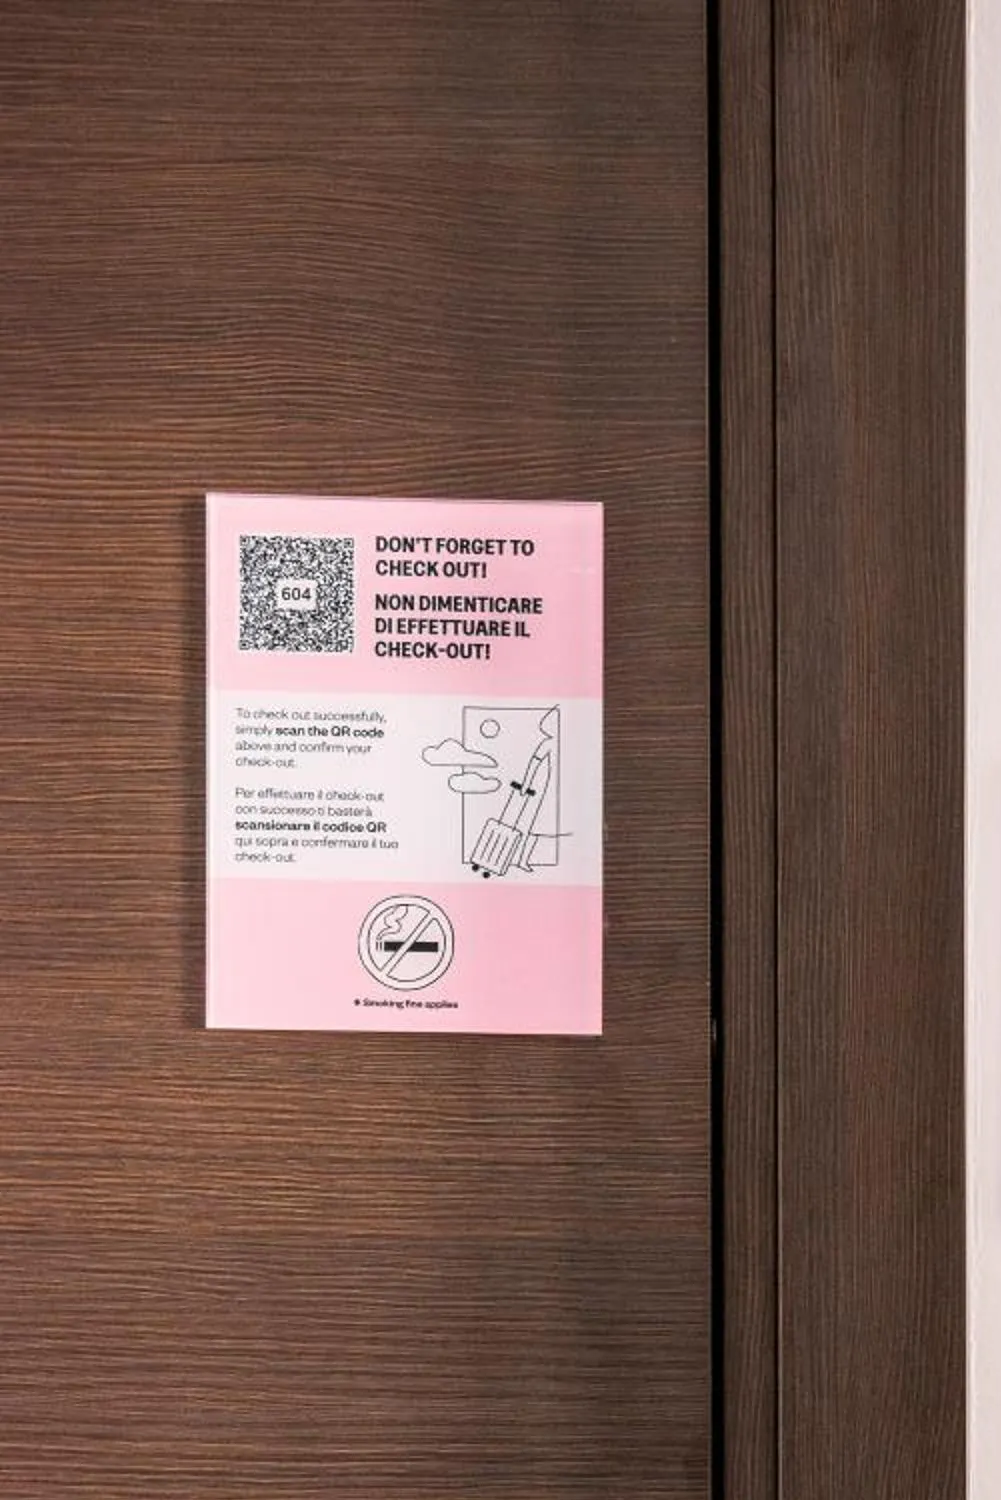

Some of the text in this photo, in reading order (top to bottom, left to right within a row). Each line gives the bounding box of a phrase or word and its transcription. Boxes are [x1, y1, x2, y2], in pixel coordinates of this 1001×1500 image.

[375, 536, 535, 556] DON'T FORGET TO
[375, 560, 487, 578] CHECK OUT!
[281, 587, 311, 601] 604
[375, 594, 543, 614] NON DIMENTICARE
[375, 618, 530, 637] DI EFFETTUARE IL
[375, 641, 490, 660] CHECK-OUT!
[236, 708, 250, 719] To
[253, 710, 288, 720] check
[292, 711, 310, 720] out
[235, 724, 384, 738] simply scan the QR code
[235, 740, 372, 756] above and confirm your
[235, 787, 384, 801] Per effettuare il check-out
[235, 806, 257, 815] con
[259, 806, 316, 816] successo
[327, 806, 372, 817] basterà
[235, 820, 386, 832] scansionare il codice QR
[235, 837, 399, 849] qui sopra e confermare il tuo
[363, 998, 459, 1010] Smoking fine applies
